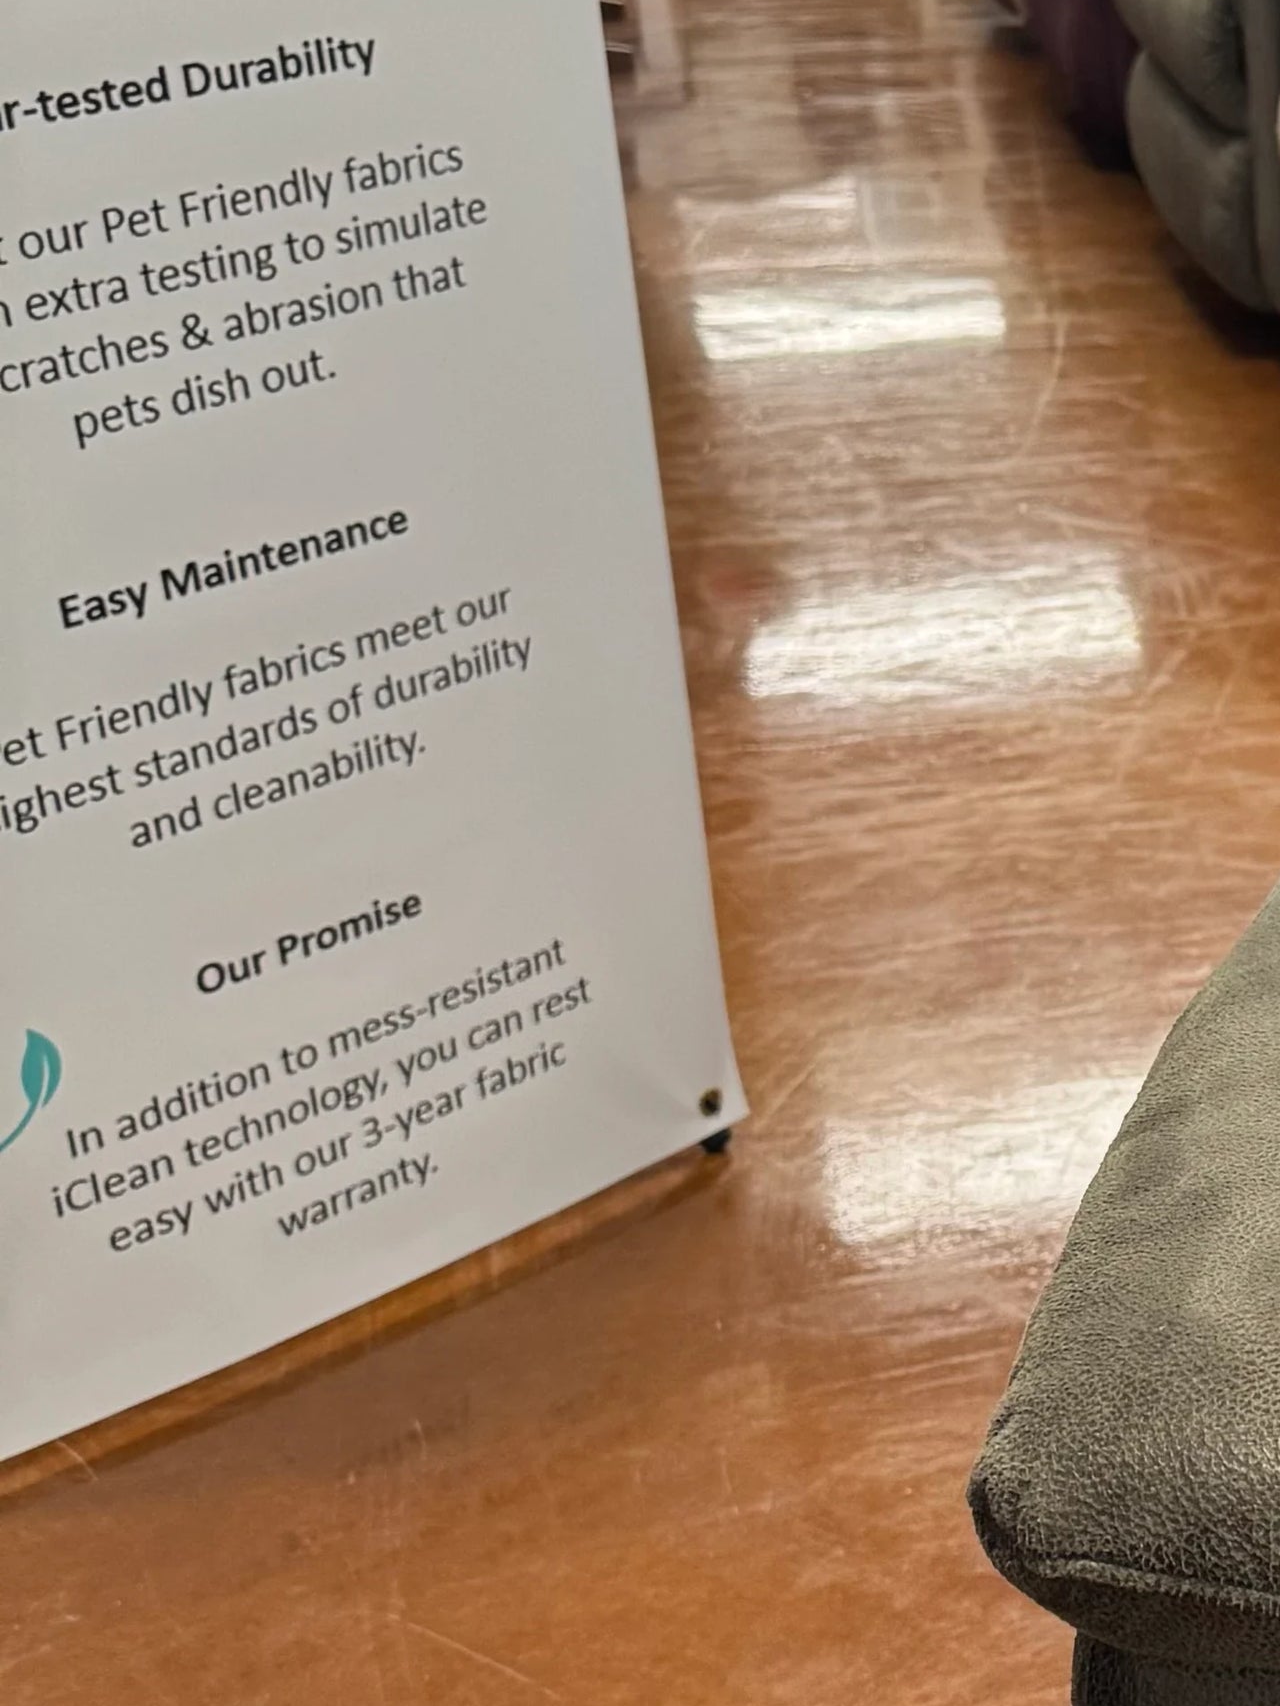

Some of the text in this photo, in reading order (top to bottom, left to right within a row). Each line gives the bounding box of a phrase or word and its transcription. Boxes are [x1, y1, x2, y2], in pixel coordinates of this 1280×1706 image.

[181, 37, 375, 98] Durability
[18, 221, 88, 259] our
[102, 199, 169, 243] Pet
[179, 167, 333, 228] Friendly
[343, 144, 463, 193] fabrics
[25, 276, 129, 321] extra
[139, 244, 277, 296] testing
[284, 232, 325, 264] to
[336, 197, 487, 254] simulate
[181, 313, 214, 350] &
[224, 282, 383, 341] abrasion
[392, 257, 466, 301] that
[73, 350, 336, 450] pets dish out.
[58, 511, 408, 629] Easy Maintenance
[55, 680, 212, 751] Friendly
[223, 641, 346, 699] fabrics
[355, 606, 447, 659] meet
[456, 588, 510, 627] our
[134, 705, 318, 788] standards
[328, 683, 362, 724] of
[374, 637, 530, 710] durability
[130, 731, 425, 848] and cleanability.
[196, 894, 422, 994] Our Promise
[52, 977, 589, 1218] iClean technology, you can rest
[66, 939, 565, 1159] In addition to mess-resistant
[109, 1043, 565, 1251] easy with our 3-year fabric
[277, 1154, 438, 1237] warranty.
